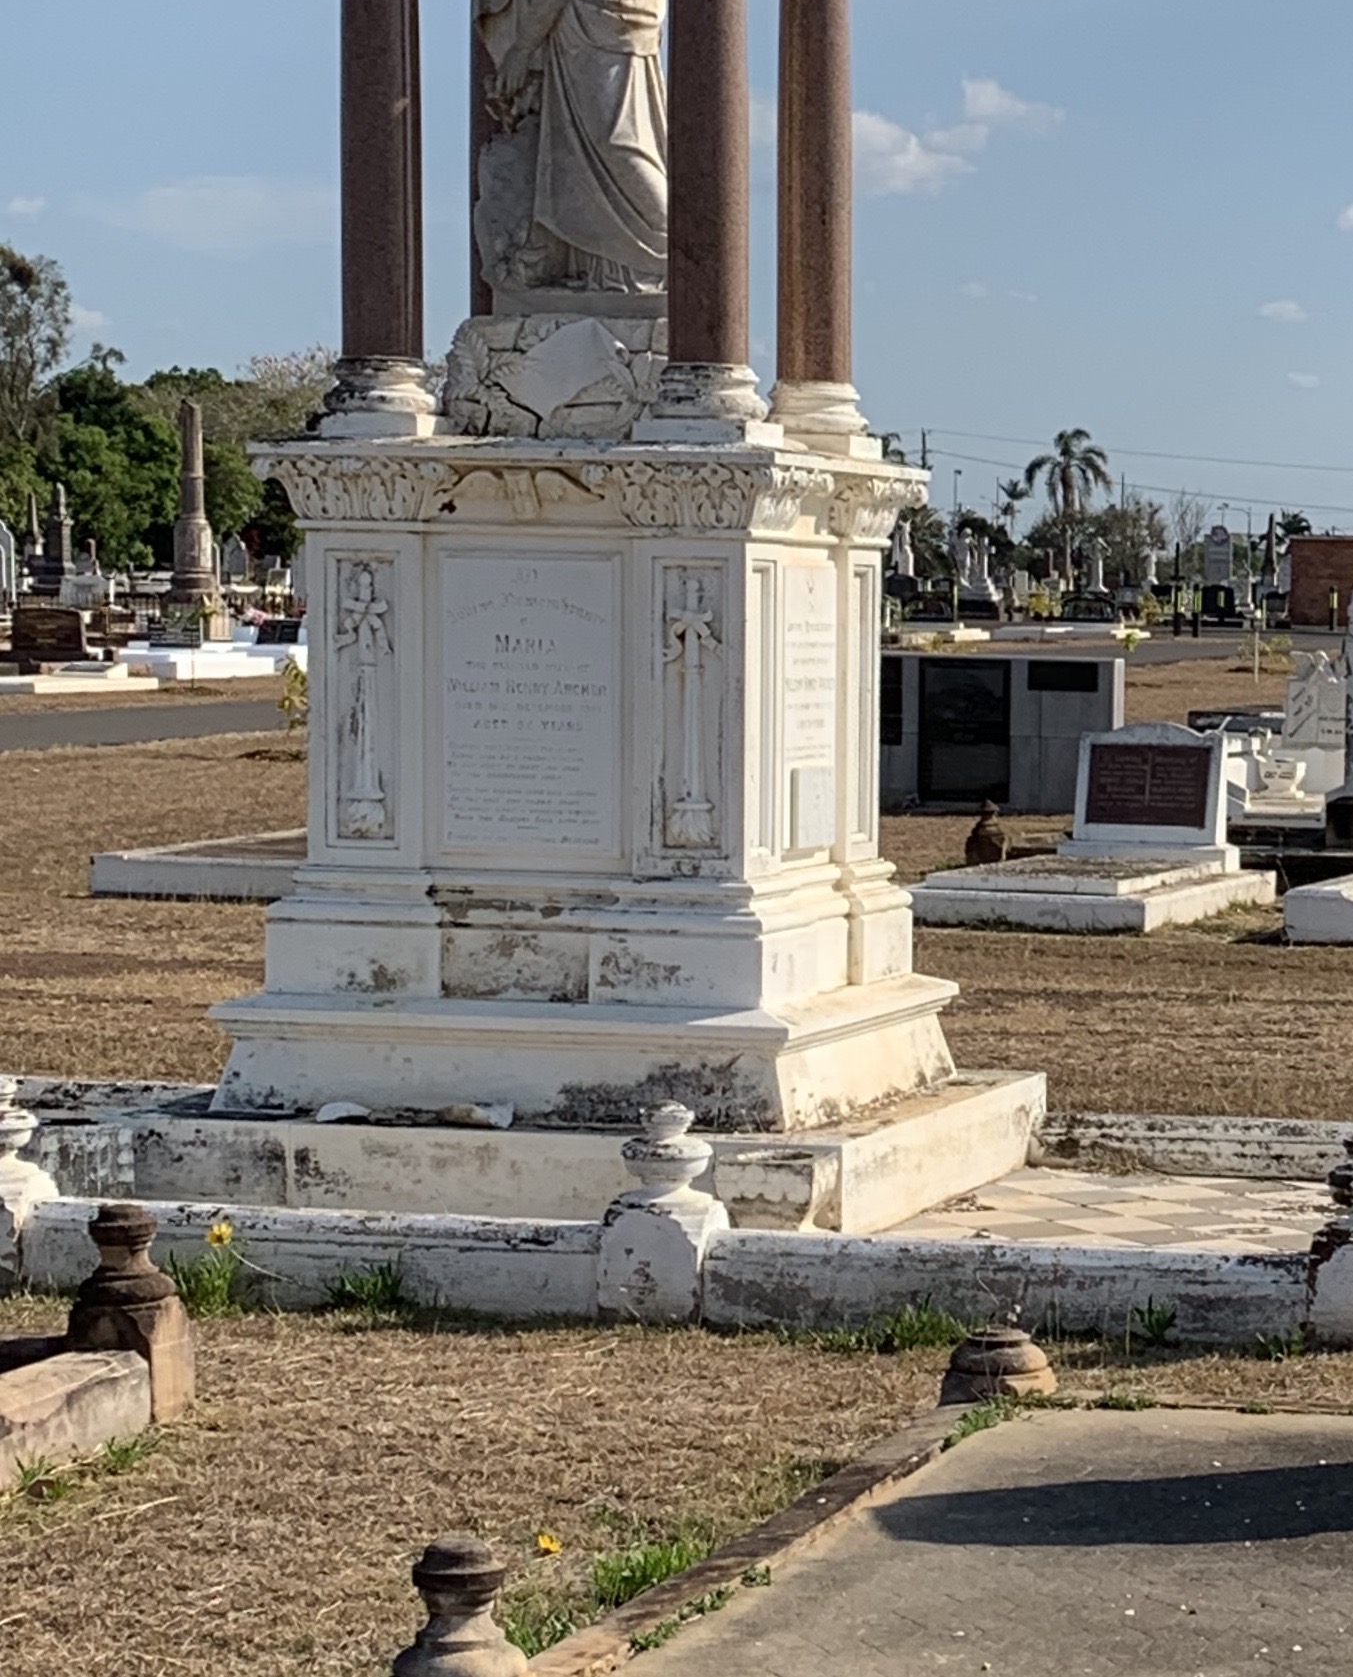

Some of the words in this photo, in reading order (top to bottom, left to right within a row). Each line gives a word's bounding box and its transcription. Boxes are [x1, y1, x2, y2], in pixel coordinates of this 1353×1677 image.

[494, 634, 558, 654] MARIA
[505, 679, 550, 695] HENRY
[553, 680, 607, 697] ARCHER
